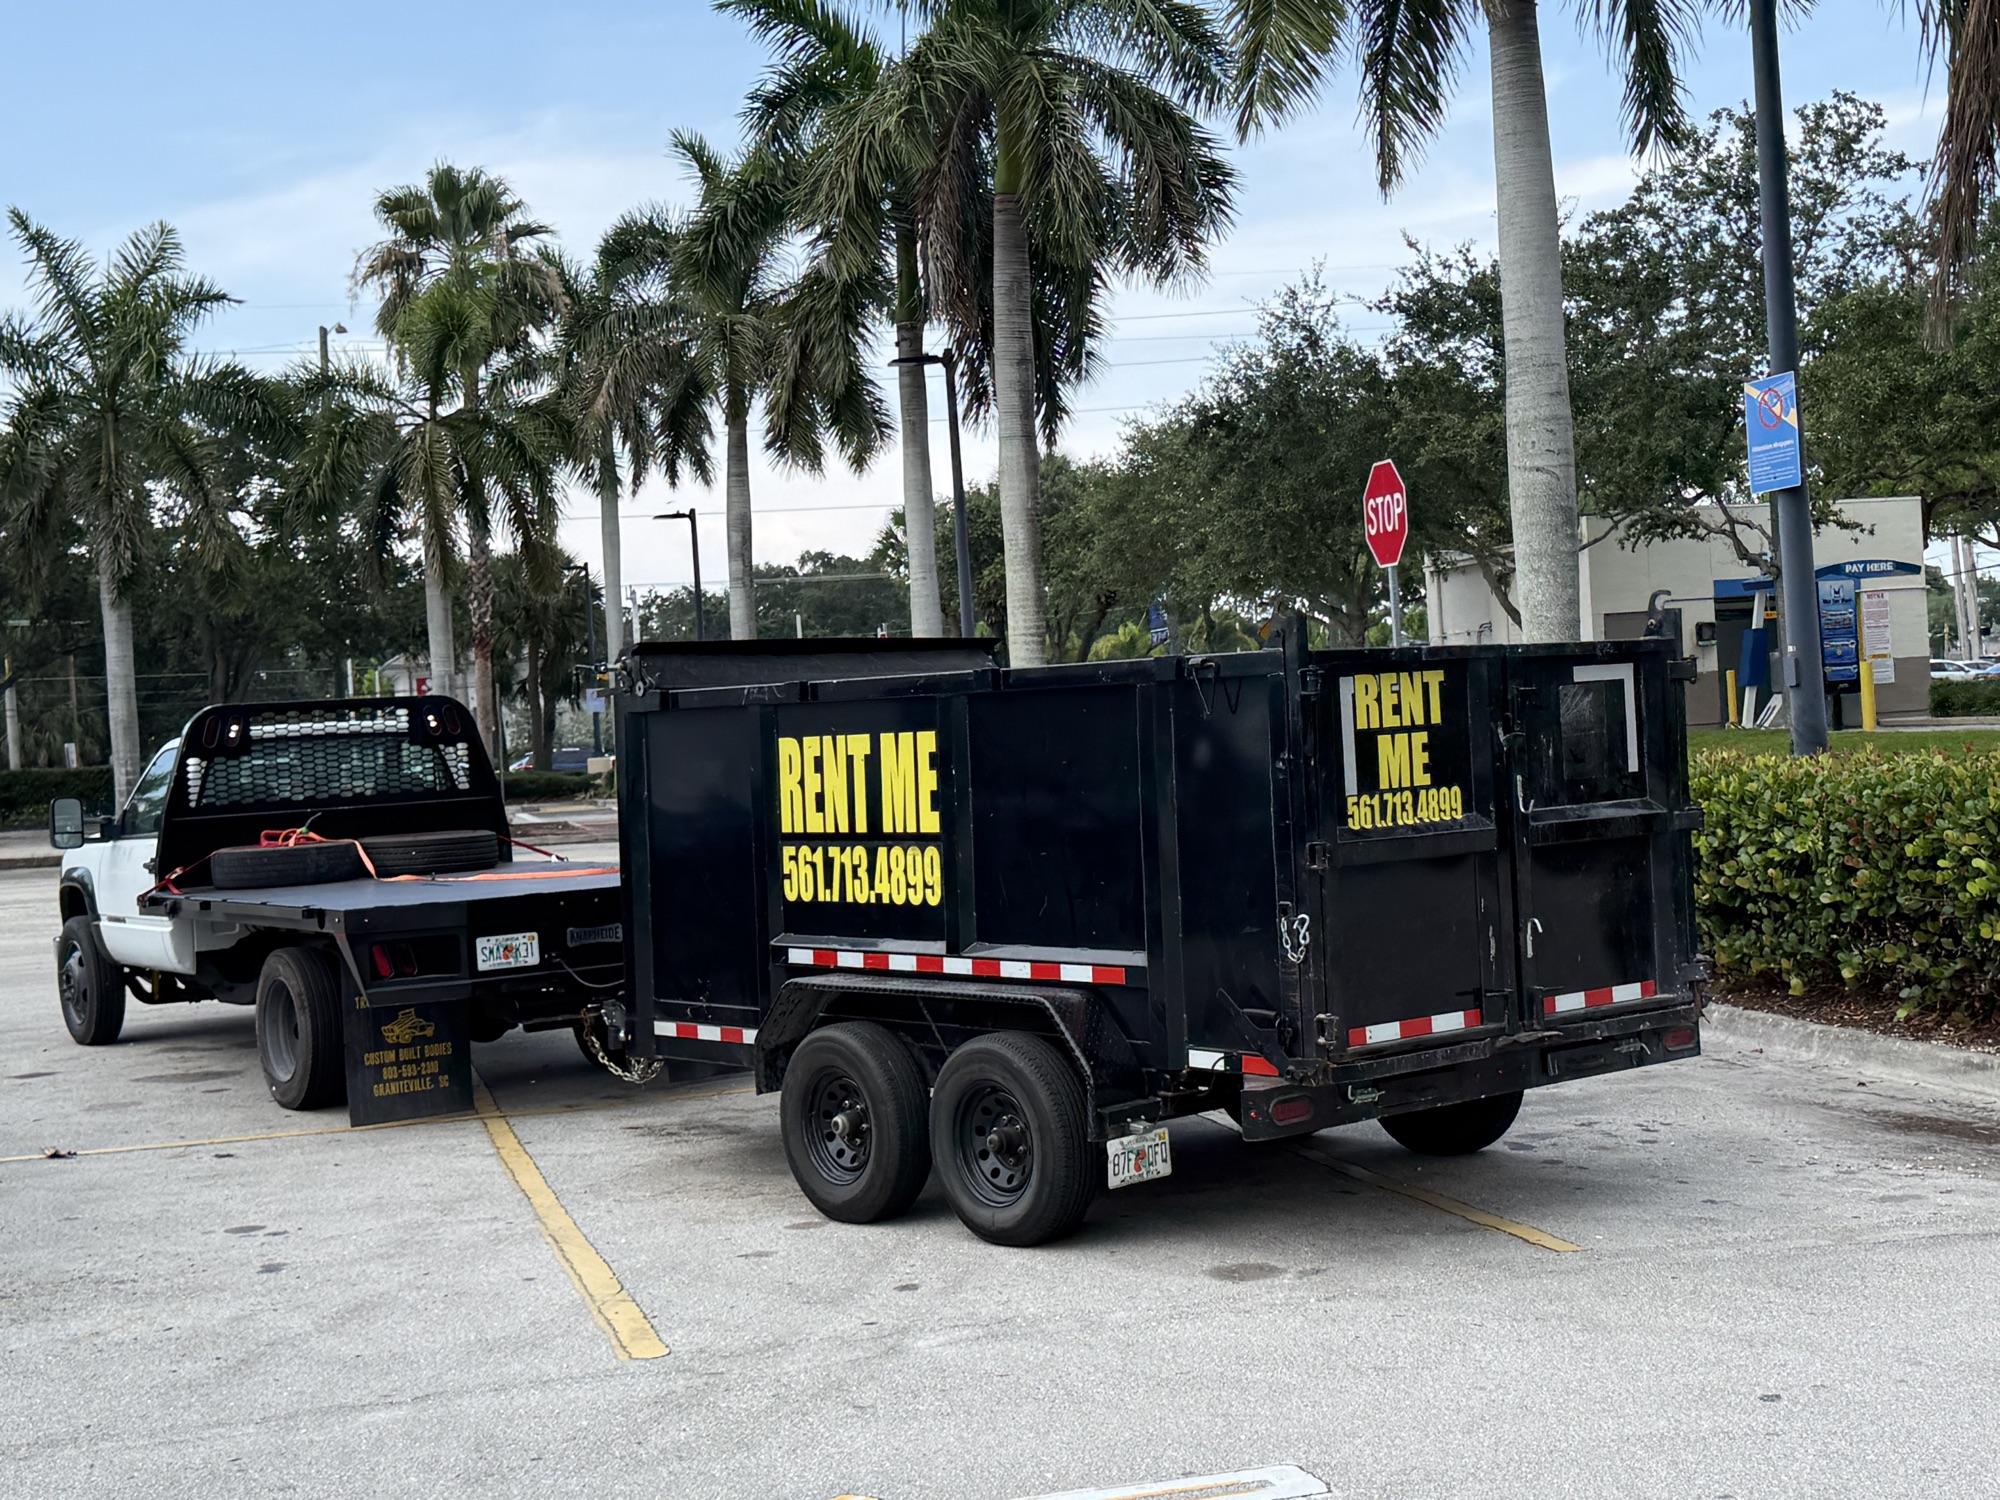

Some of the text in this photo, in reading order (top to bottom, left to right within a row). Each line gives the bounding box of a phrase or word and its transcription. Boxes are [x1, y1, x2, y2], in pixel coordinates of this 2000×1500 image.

[1367, 492, 1403, 536] STOP
[1845, 561, 1894, 573] PAY HERE
[1354, 670, 1445, 730] RENT
[778, 731, 940, 833] RENT ME
[1377, 731, 1432, 789] ME
[1347, 785, 1464, 831] 561.713.4899
[782, 845, 942, 906] 561.713.4899
[364, 1041, 452, 1066] CUSTOM BUILT BODIES
[438, 1075, 449, 1088] SC
